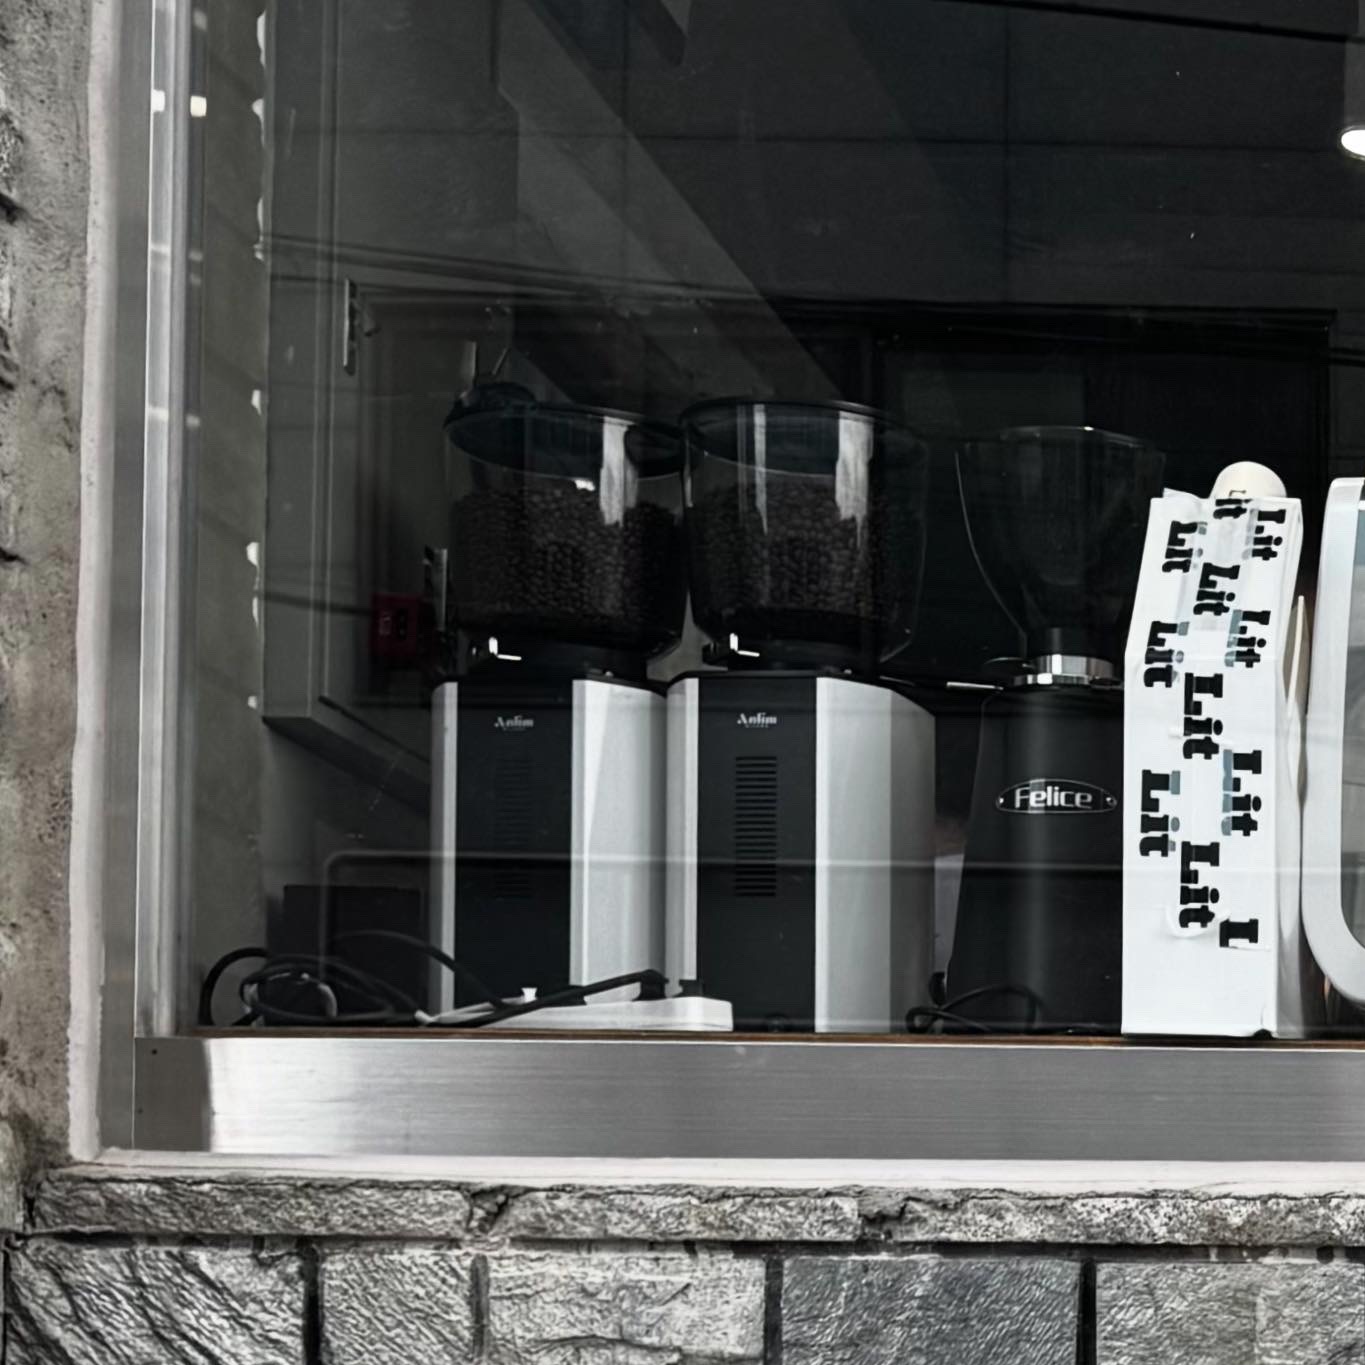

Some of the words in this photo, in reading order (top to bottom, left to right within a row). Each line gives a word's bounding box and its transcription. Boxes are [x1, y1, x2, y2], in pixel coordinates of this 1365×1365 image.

[1193, 562, 1240, 616] Lit
[1143, 621, 1190, 687] Lit
[1225, 609, 1271, 668] Lit
[1183, 672, 1224, 760] Lit
[1014, 785, 1093, 809] Felice
[1139, 769, 1181, 857] Lit
[1221, 749, 1262, 836] Lit
[1179, 841, 1220, 928] Lit
